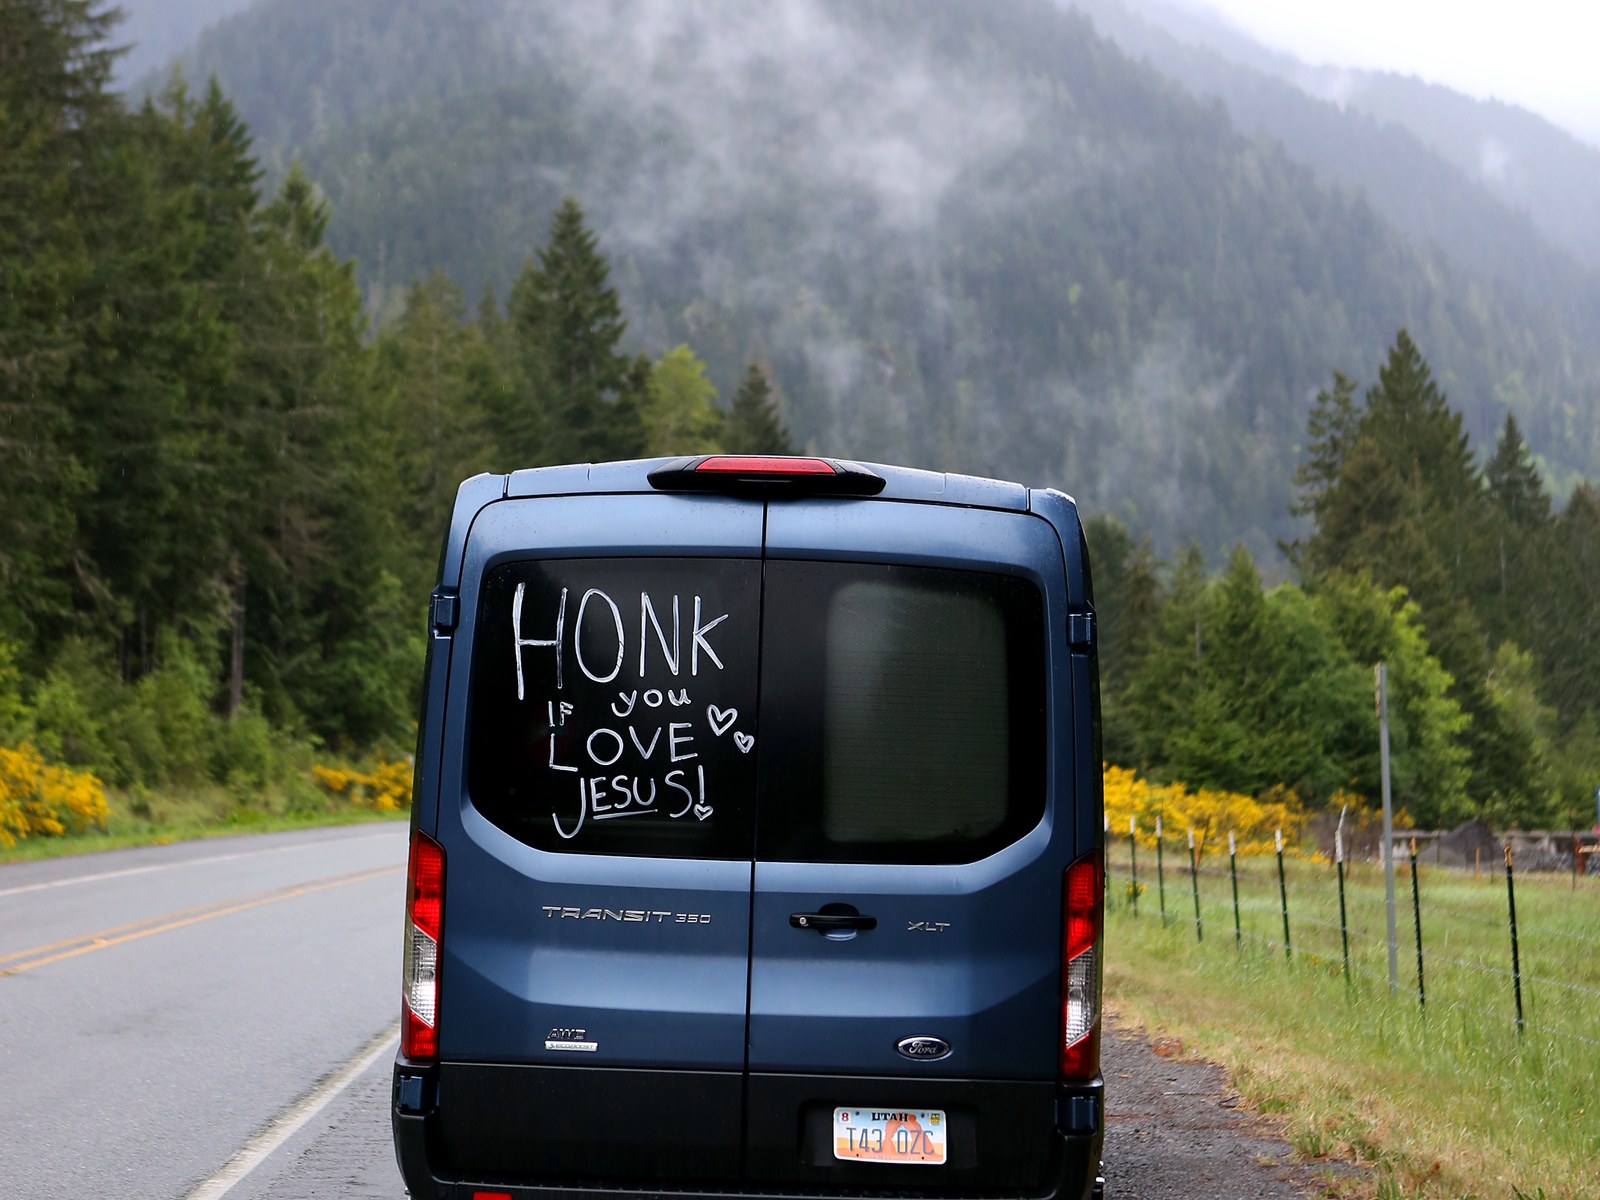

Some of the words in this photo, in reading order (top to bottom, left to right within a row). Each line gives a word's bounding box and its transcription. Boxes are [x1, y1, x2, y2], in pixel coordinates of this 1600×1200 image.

[512, 582, 729, 700] HONK
[548, 700, 574, 728] IF
[611, 688, 692, 717] you
[548, 722, 698, 772] LOVE
[552, 765, 713, 839] JESUS!
[542, 906, 672, 923] TRANSIT
[675, 913, 711, 924] 350
[907, 921, 951, 932] XLT
[909, 1041, 937, 1054] Ford
[841, 1112, 849, 1122] 8
[871, 1112, 908, 1122] UTAH
[846, 1127, 883, 1153] T43
